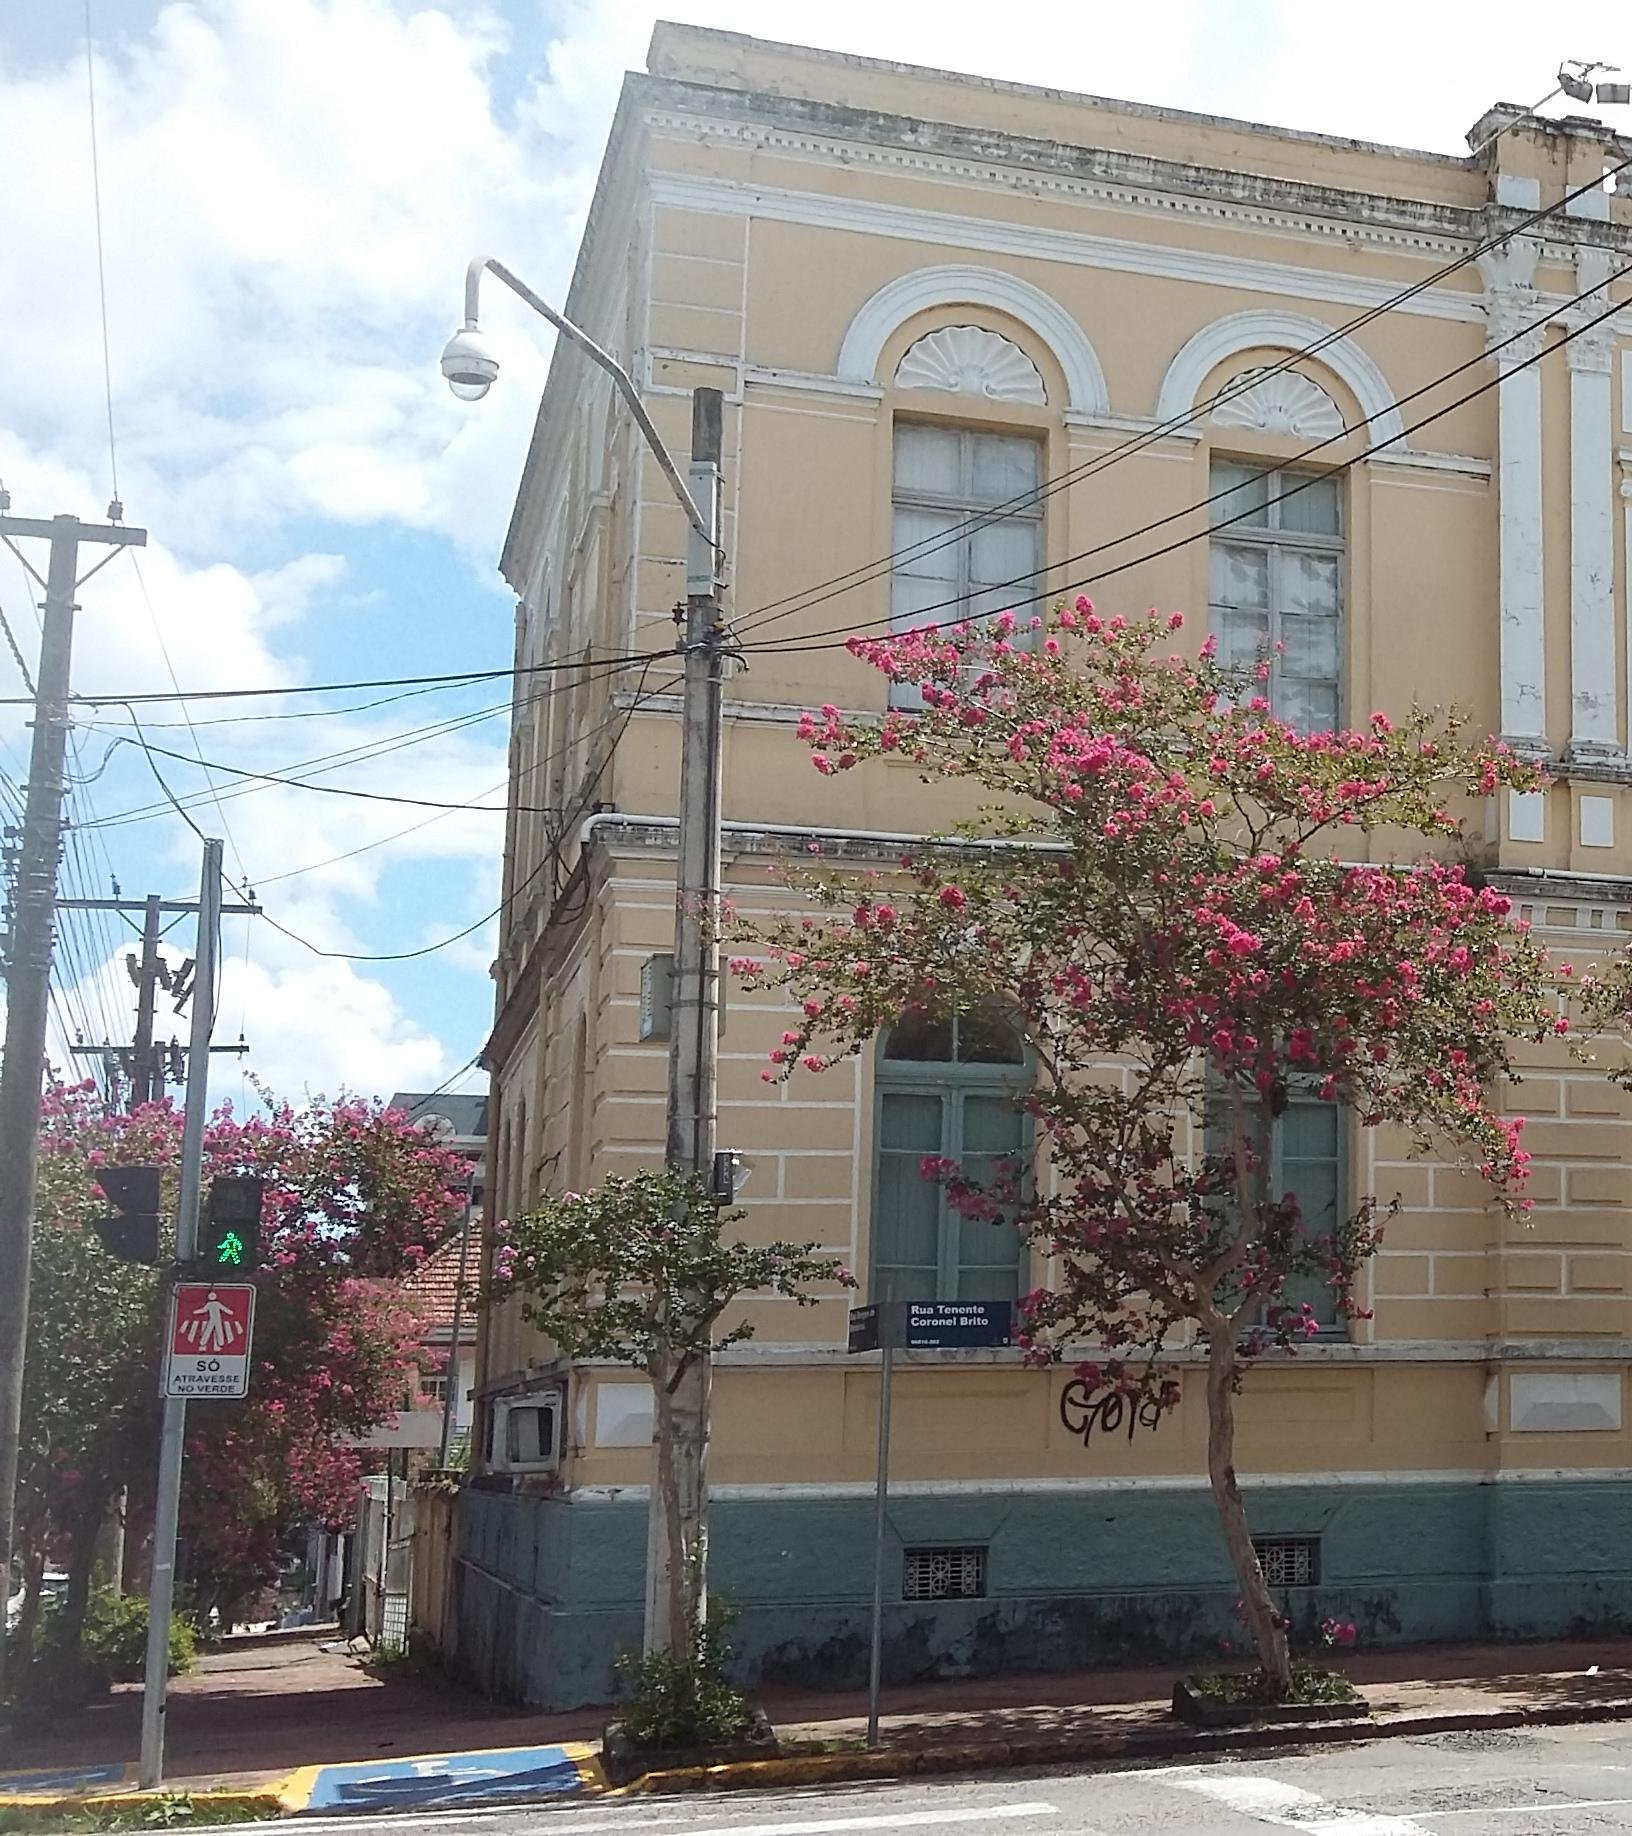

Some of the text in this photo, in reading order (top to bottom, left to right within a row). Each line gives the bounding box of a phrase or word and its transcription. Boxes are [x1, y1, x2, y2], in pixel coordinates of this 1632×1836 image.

[911, 1305, 985, 1315] Rua Tenente
[911, 1317, 989, 1327] Coronel Brito
[196, 1358, 220, 1372] SÓ
[174, 1375, 240, 1383] ATRAVESSE
[177, 1385, 236, 1393] NO VERDE
